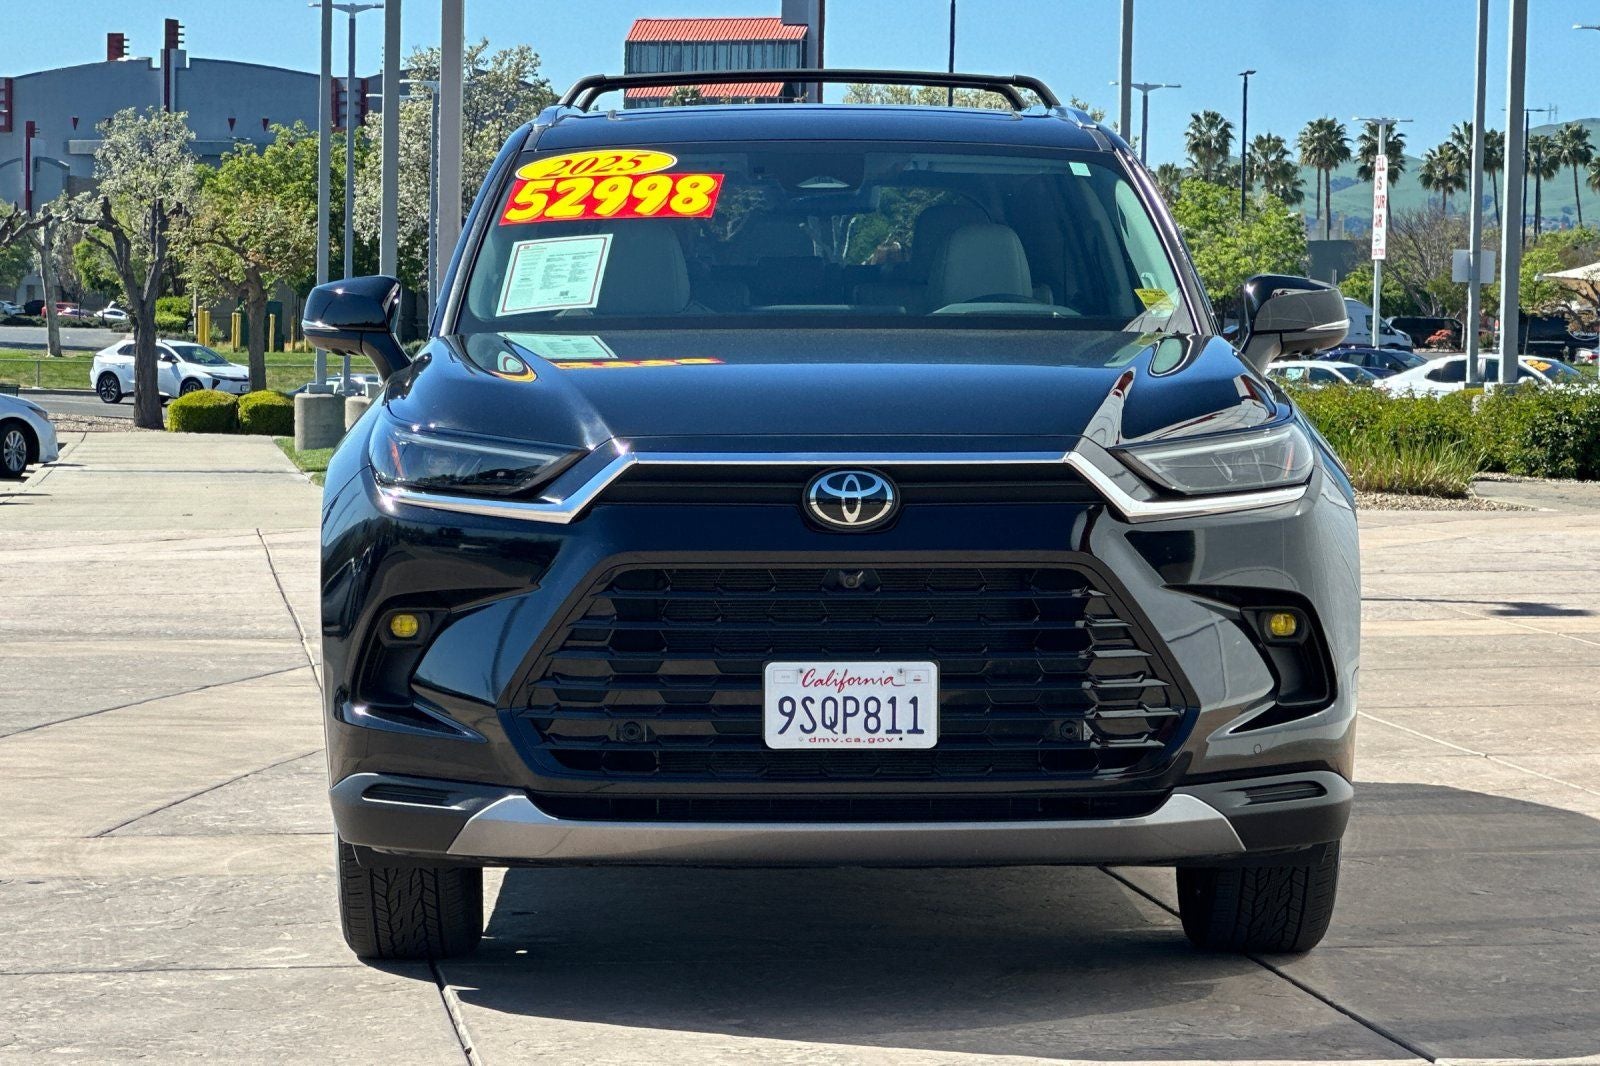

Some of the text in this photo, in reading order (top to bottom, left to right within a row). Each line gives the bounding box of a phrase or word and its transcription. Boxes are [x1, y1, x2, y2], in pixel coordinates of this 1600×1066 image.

[546, 154, 650, 177] 2025
[504, 174, 717, 222] 52998
[801, 668, 906, 693] California
[777, 695, 925, 735] 9SQP811
[808, 736, 895, 744] dmv.ca.gov
